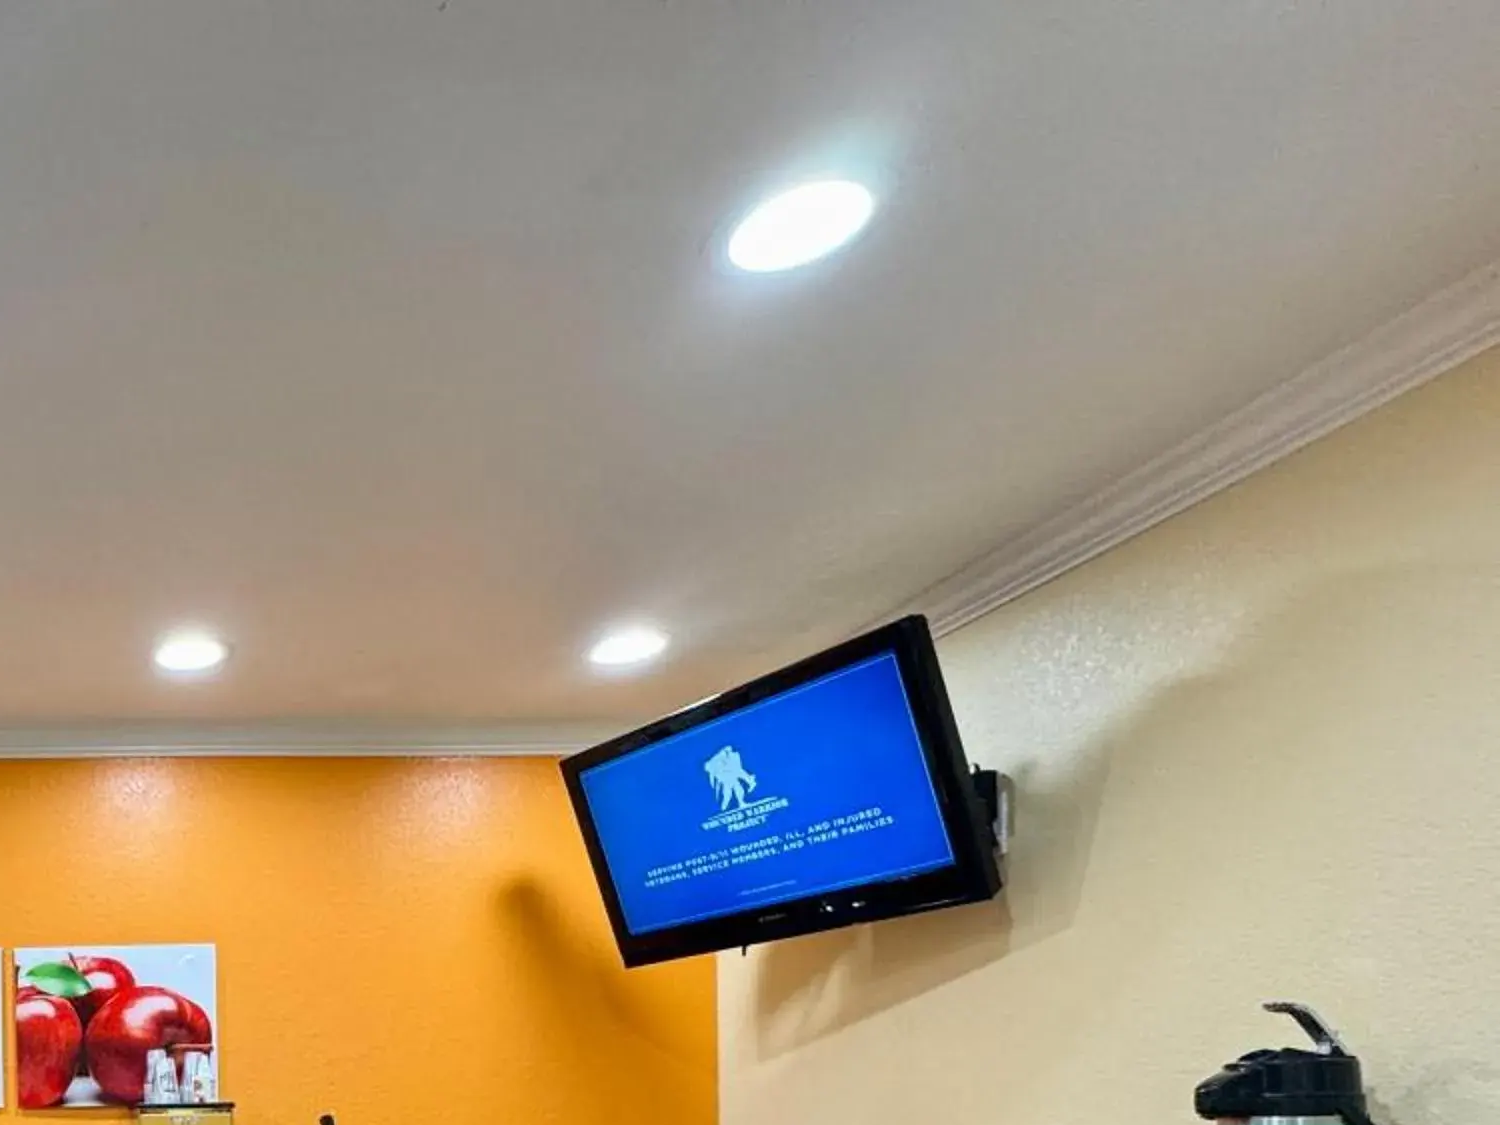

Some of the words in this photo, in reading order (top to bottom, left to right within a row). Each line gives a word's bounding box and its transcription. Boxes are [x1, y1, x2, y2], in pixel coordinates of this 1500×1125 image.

[808, 821, 831, 834] AND
[833, 807, 882, 828] INJURED
[692, 860, 729, 876] SERVICE
[783, 839, 805, 852] AND
[806, 830, 839, 845] THEIR
[841, 816, 894, 836] FAMILIES
